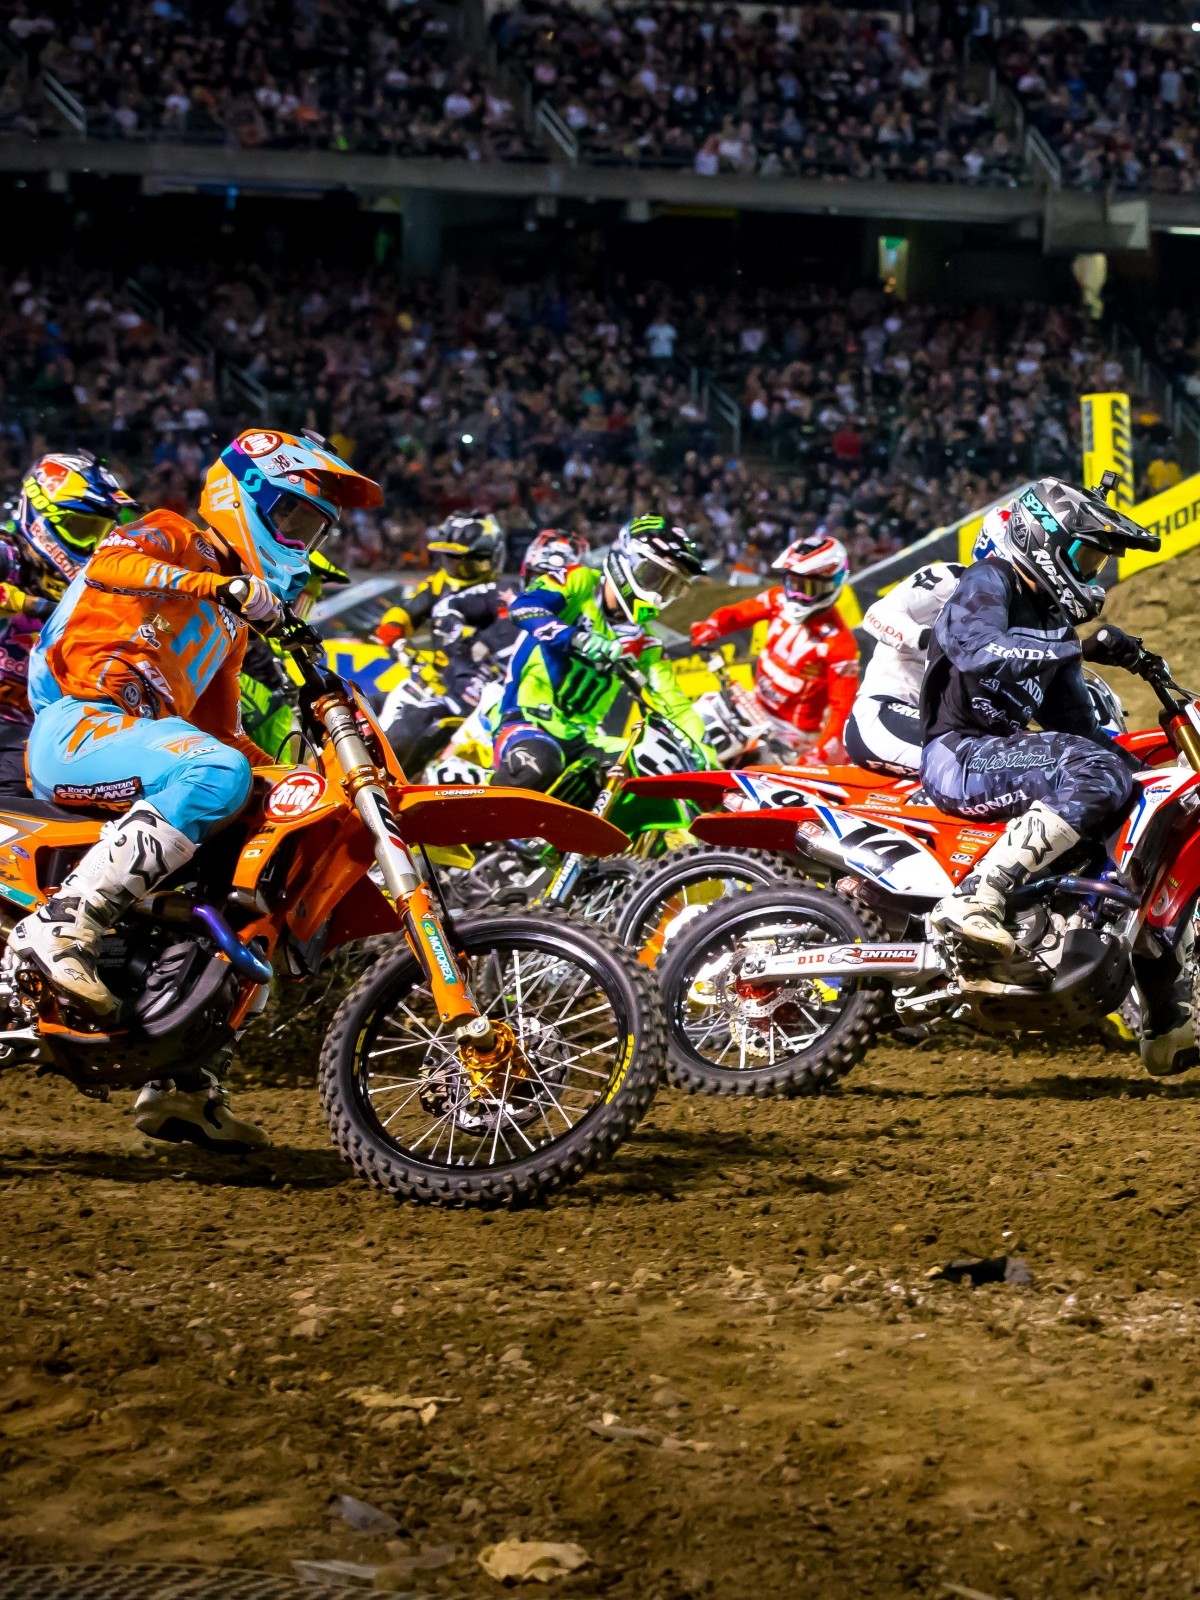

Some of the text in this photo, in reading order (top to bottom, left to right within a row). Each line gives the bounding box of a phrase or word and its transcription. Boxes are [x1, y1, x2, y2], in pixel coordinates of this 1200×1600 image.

[208, 473, 238, 512] FLY
[768, 617, 818, 666] FLY
[986, 643, 1059, 660] HONDA
[67, 780, 134, 795] ROCKY MOUNTAIN
[434, 788, 485, 796] LOENBRO
[1145, 784, 1172, 795] HRC
[958, 789, 1031, 816] HONDA
[840, 820, 921, 877] 14
[428, 935, 456, 981] MOTOREX
